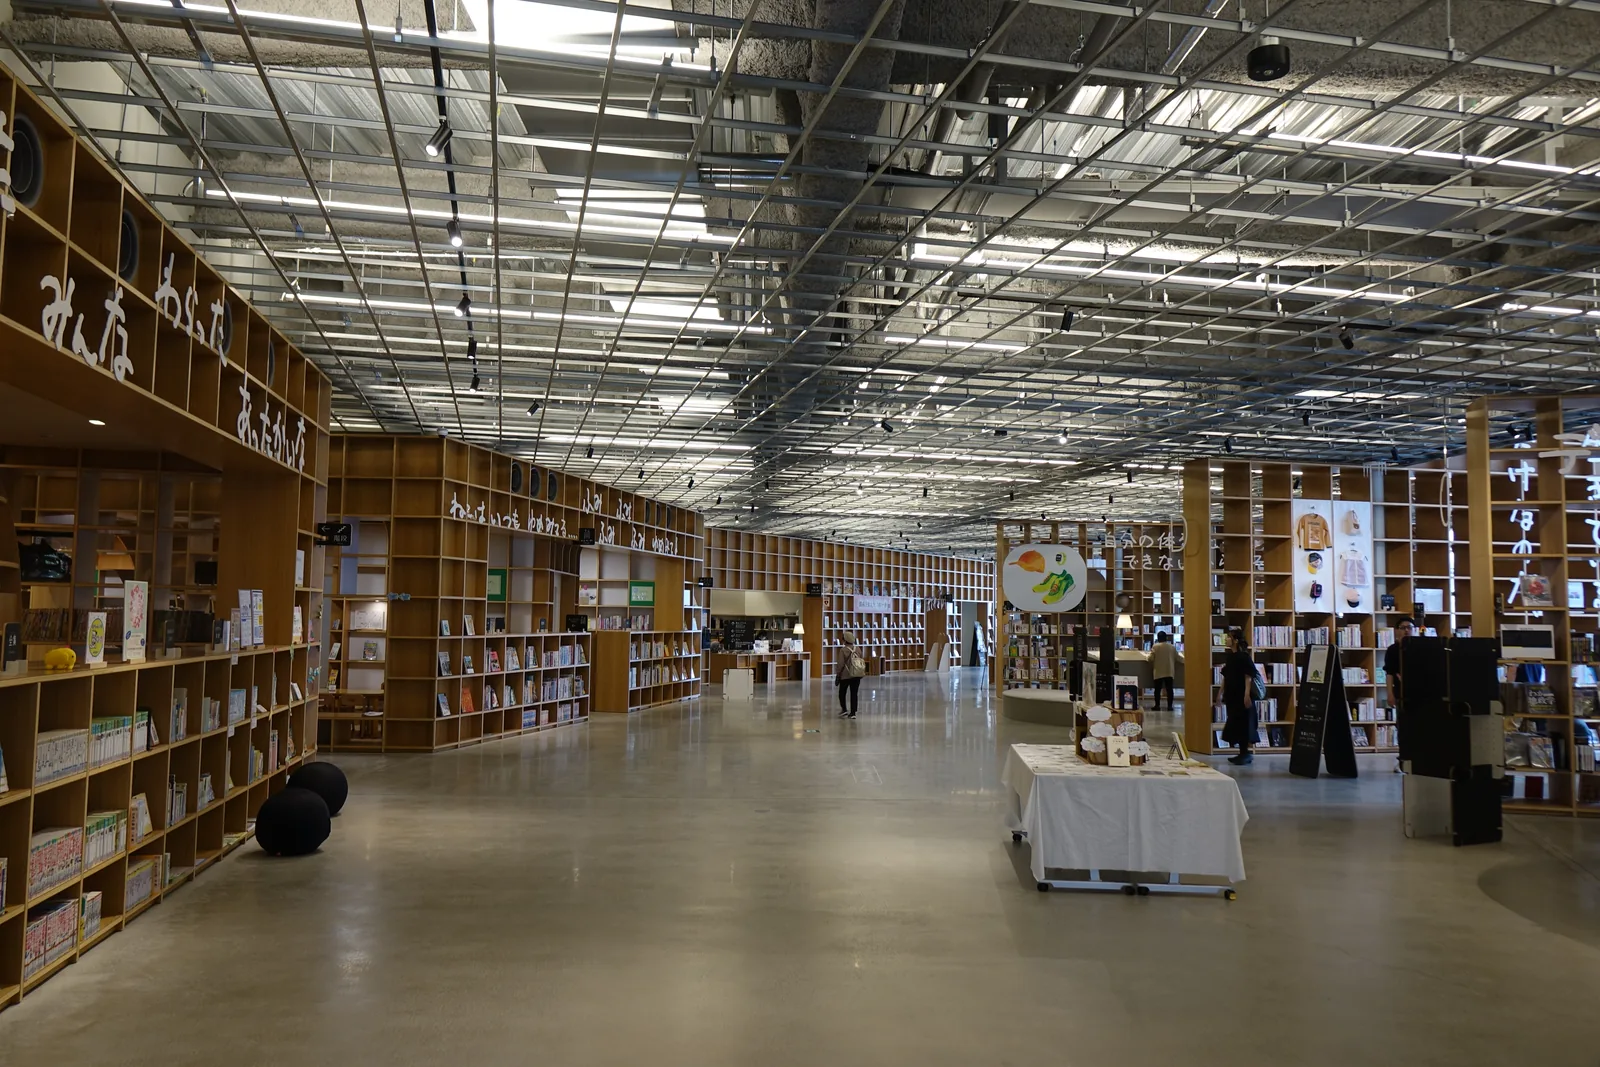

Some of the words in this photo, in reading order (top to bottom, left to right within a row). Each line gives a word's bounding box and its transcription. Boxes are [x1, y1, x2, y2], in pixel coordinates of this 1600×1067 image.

[40, 274, 134, 383] みんな
[237, 371, 306, 474] あったかいな
[449, 491, 486, 524] ねこは
[490, 508, 521, 530] いつも
[582, 487, 602, 515] ふみ
[615, 497, 632, 524] ふみ
[598, 520, 616, 545] ふみ
[630, 526, 646, 550] ふみ
